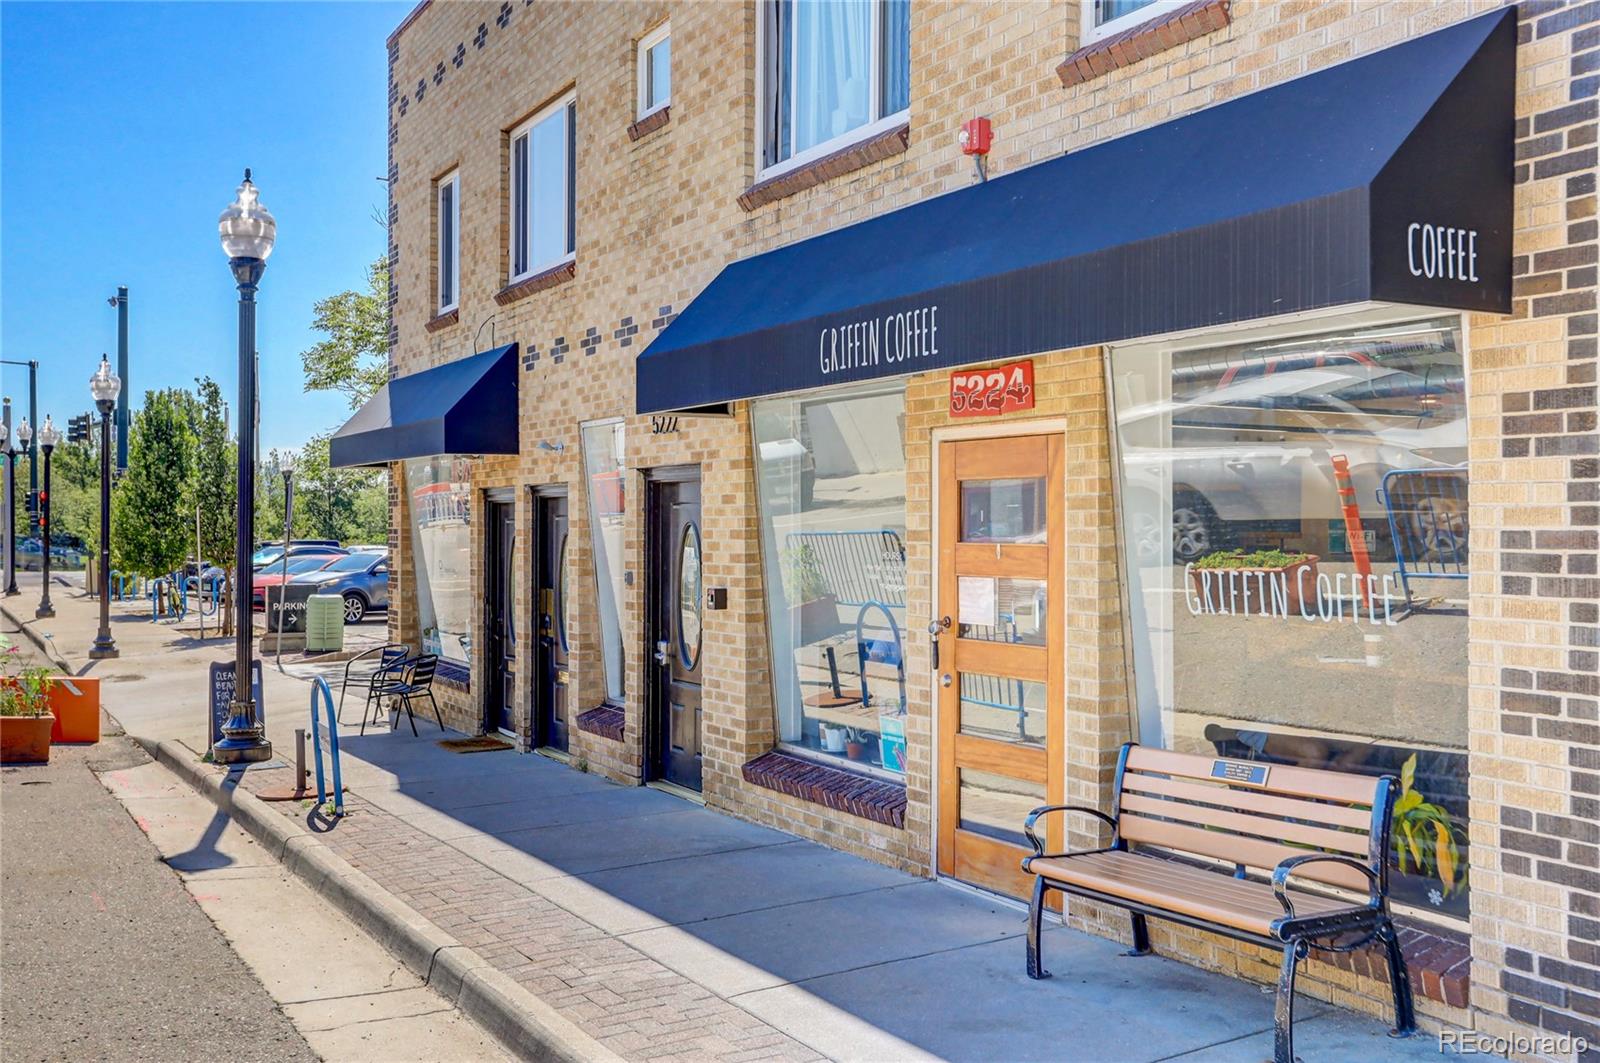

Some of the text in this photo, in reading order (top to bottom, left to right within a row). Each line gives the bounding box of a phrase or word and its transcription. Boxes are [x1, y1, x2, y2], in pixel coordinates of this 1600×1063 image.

[1408, 222, 1479, 282] COFFEE
[820, 305, 939, 374] GRIFFIN COFFEE
[951, 366, 1031, 413] 5224
[652, 415, 680, 434] 5222
[272, 602, 307, 611] PARKIN
